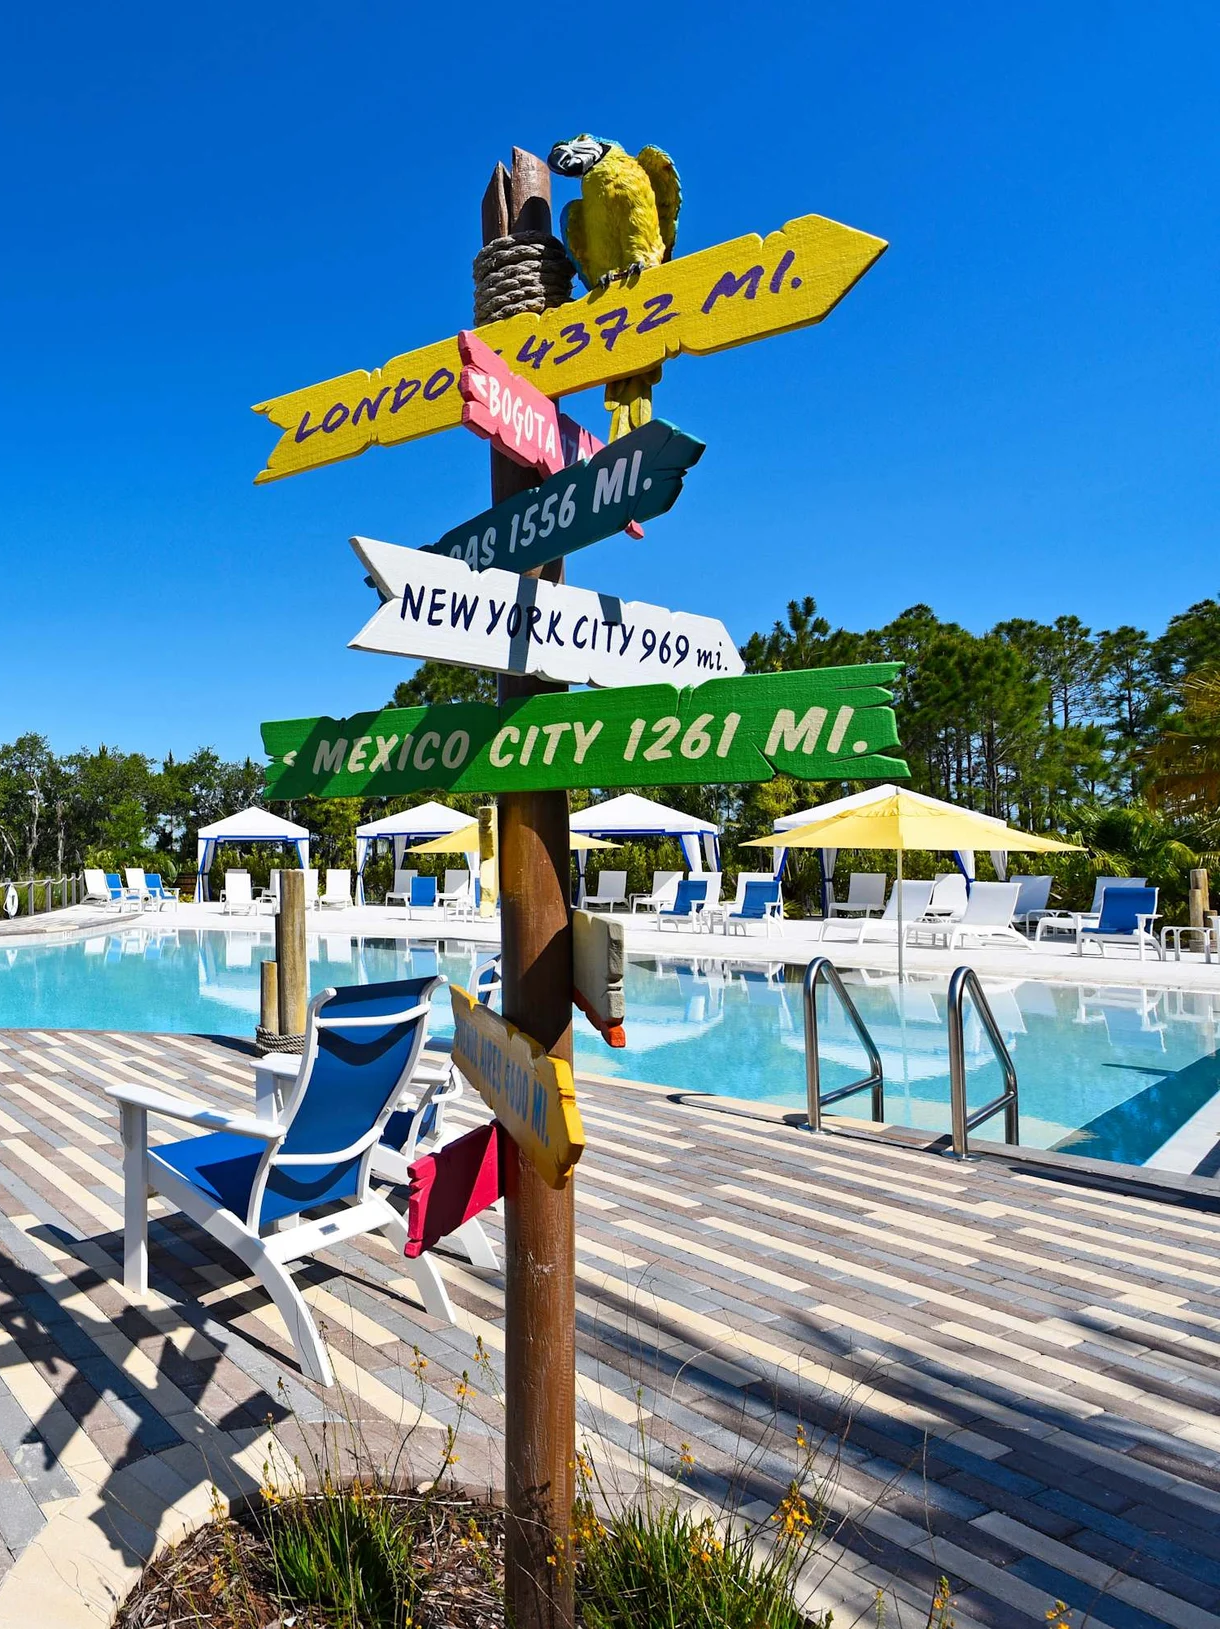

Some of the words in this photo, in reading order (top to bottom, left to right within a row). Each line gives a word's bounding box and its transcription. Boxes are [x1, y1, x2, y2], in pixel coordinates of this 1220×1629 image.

[295, 351, 479, 443] LONDO
[516, 294, 679, 370] 4372
[701, 250, 802, 314] MI.
[488, 376, 556, 459] BOGOTA
[509, 483, 577, 553] 1556
[592, 450, 652, 513] MI.
[400, 582, 479, 632] NEW
[485, 599, 565, 647] YORK
[572, 615, 635, 656] CITY
[639, 629, 690, 668] 969
[696, 642, 728, 671] mi.
[312, 730, 470, 775] MEXICO
[489, 720, 604, 768] CITY
[623, 712, 741, 762] 1261
[764, 705, 868, 756] MI.
[532, 1079, 550, 1148] MI.
